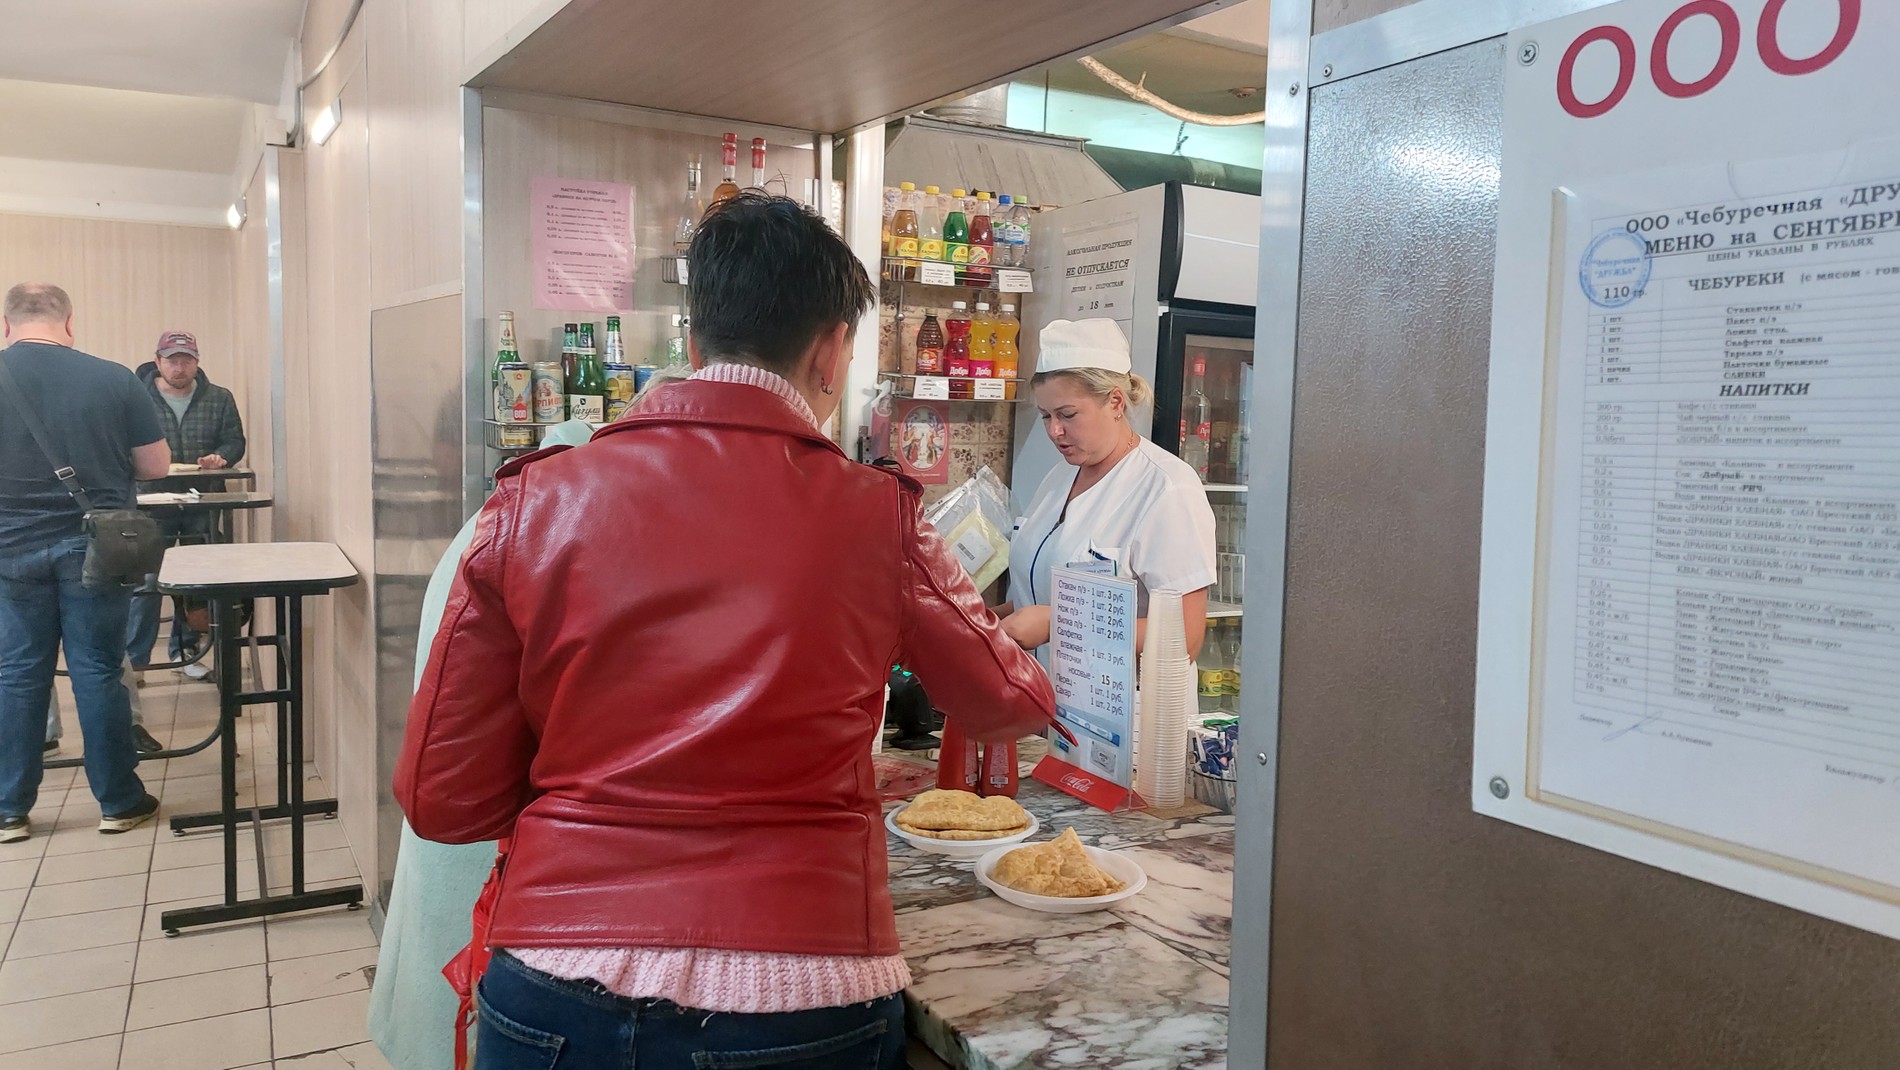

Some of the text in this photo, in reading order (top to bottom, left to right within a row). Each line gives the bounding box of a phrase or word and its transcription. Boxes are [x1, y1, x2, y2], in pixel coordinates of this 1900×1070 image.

[1556, 0, 1861, 119] ООО
[1626, 214, 1670, 234] ООО
[1677, 198, 1822, 226] «Чебуречная
[1644, 233, 1715, 255] МЕНЮ
[1731, 232, 1756, 245] на
[1707, 237, 1874, 262] ЦЕНЫ УКАЗАНЫ В РУБЛЯХ
[1066, 259, 1130, 277] НЕ ОТПУСКАЕТСЯ
[1688, 271, 1784, 291] ЧЕБУРЕКИ
[1604, 286, 1630, 299] 110
[1090, 301, 1099, 310] 18
[1720, 382, 1811, 397] НАПИТКИ
[1058, 580, 1077, 592] Стакан
[1091, 587, 1095, 596] 1
[1096, 589, 1107, 599] шт.
[1107, 590, 1112, 600] 3
[1058, 591, 1075, 603] Ложка
[1092, 599, 1095, 608] 1
[1096, 602, 1107, 611] шт.
[1108, 603, 1112, 613] 2
[1057, 603, 1070, 612] Нож
[1091, 611, 1095, 620] 1
[1095, 614, 1106, 623] шт.
[1107, 615, 1112, 626] 2
[1057, 614, 1073, 627] Вилка
[1091, 624, 1095, 633] 1
[1096, 626, 1107, 636] шт.
[1107, 629, 1112, 639] 2
[1057, 626, 1083, 641] Салфетка
[1092, 648, 1095, 657] 1
[1096, 651, 1107, 660] шт.
[1107, 652, 1112, 662] 3
[1101, 674, 1111, 686] 15
[1090, 684, 1093, 693] 1
[1106, 690, 1110, 699] 1
[1090, 697, 1094, 706] 1
[1106, 702, 1111, 711] 2
